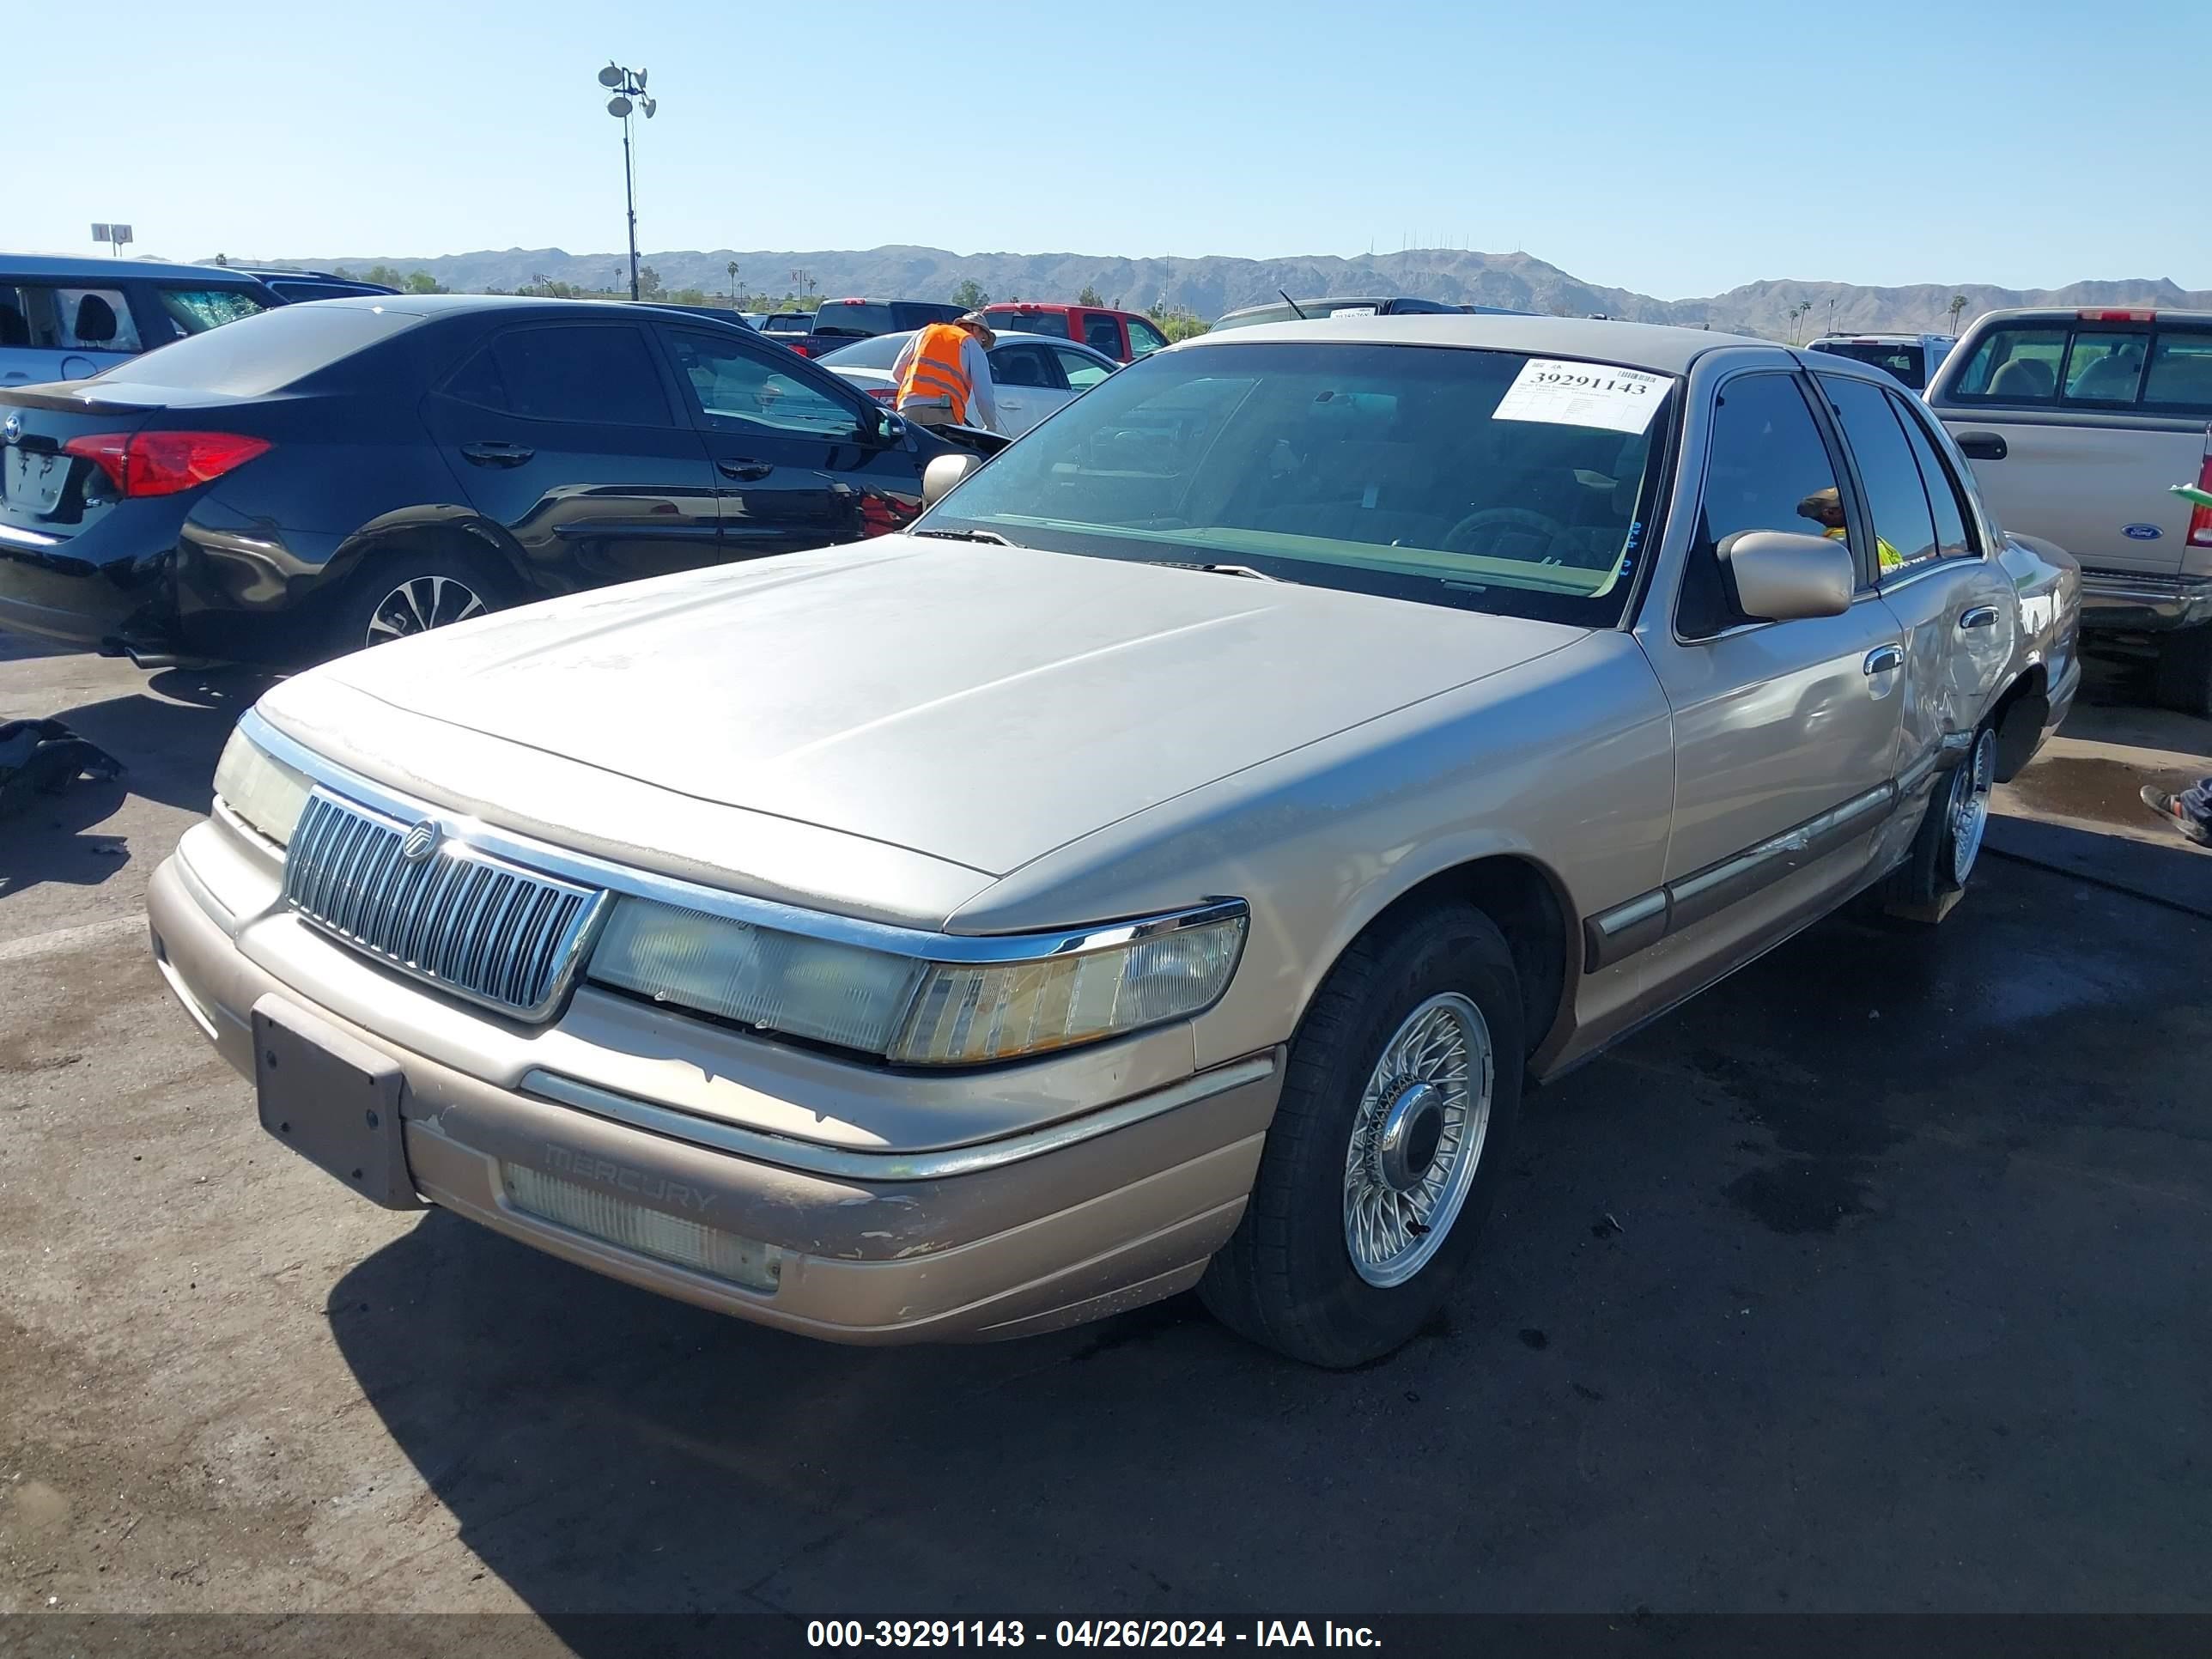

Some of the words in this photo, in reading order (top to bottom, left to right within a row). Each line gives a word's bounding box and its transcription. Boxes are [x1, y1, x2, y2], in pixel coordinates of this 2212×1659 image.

[118, 228, 128, 240] J
[792, 271, 798, 282] K
[803, 271, 808, 282] L
[1530, 372, 1647, 395] 39291143
[544, 1142, 718, 1212] MERCURY
